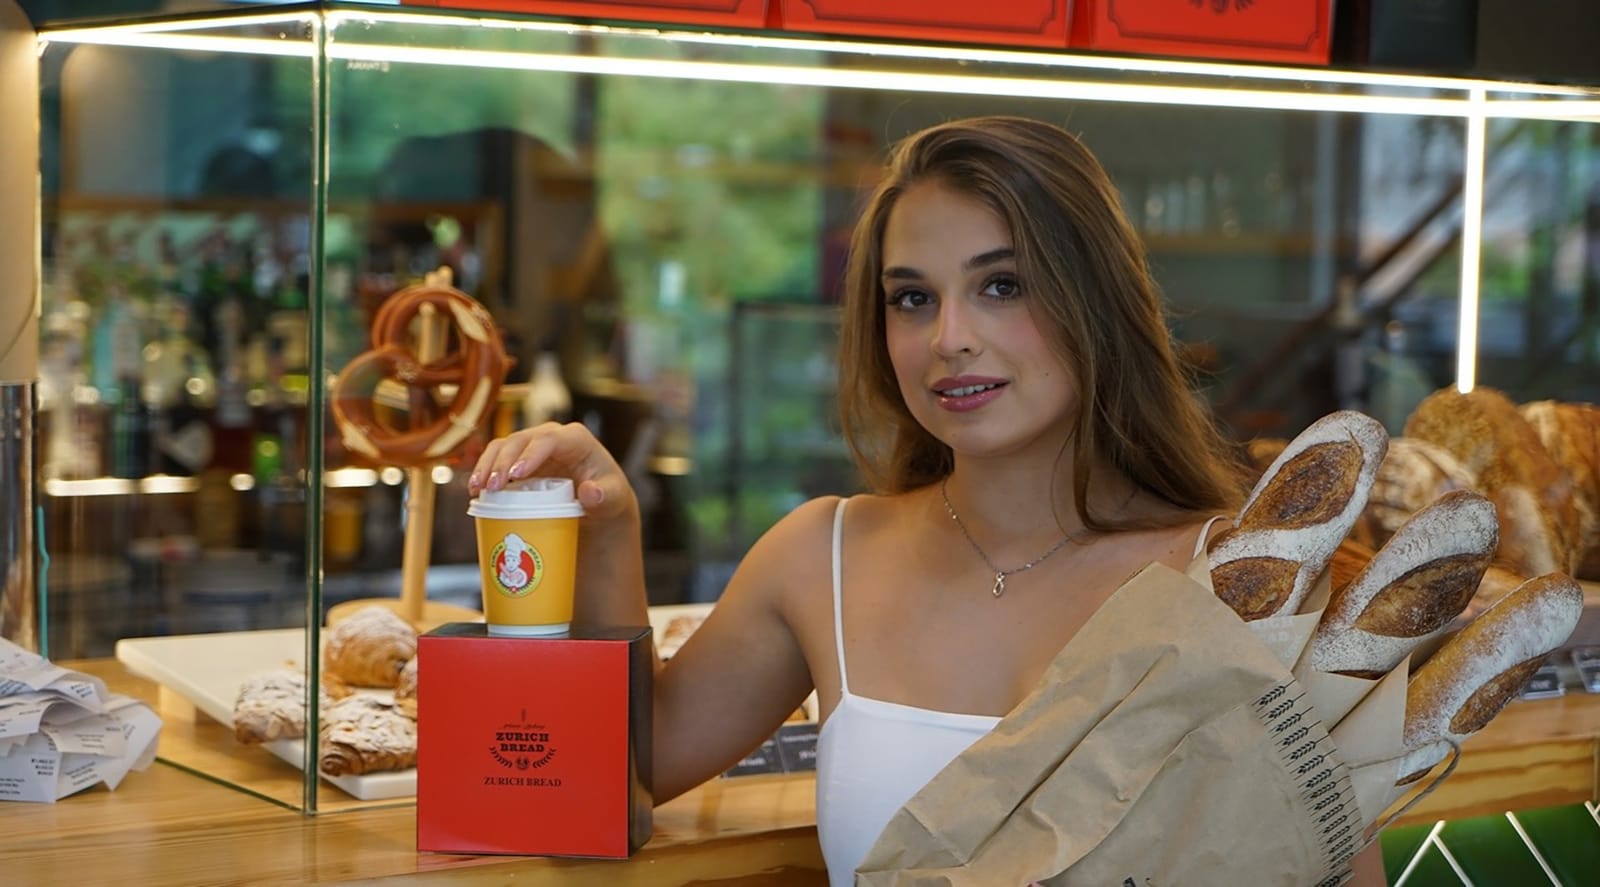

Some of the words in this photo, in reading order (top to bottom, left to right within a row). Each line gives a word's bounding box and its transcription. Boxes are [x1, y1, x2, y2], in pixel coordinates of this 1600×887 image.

[495, 731, 550, 743] ZURICH
[500, 743, 545, 753] BREAD
[483, 776, 524, 787] ZURICH
[525, 777, 562, 788] BREAD
